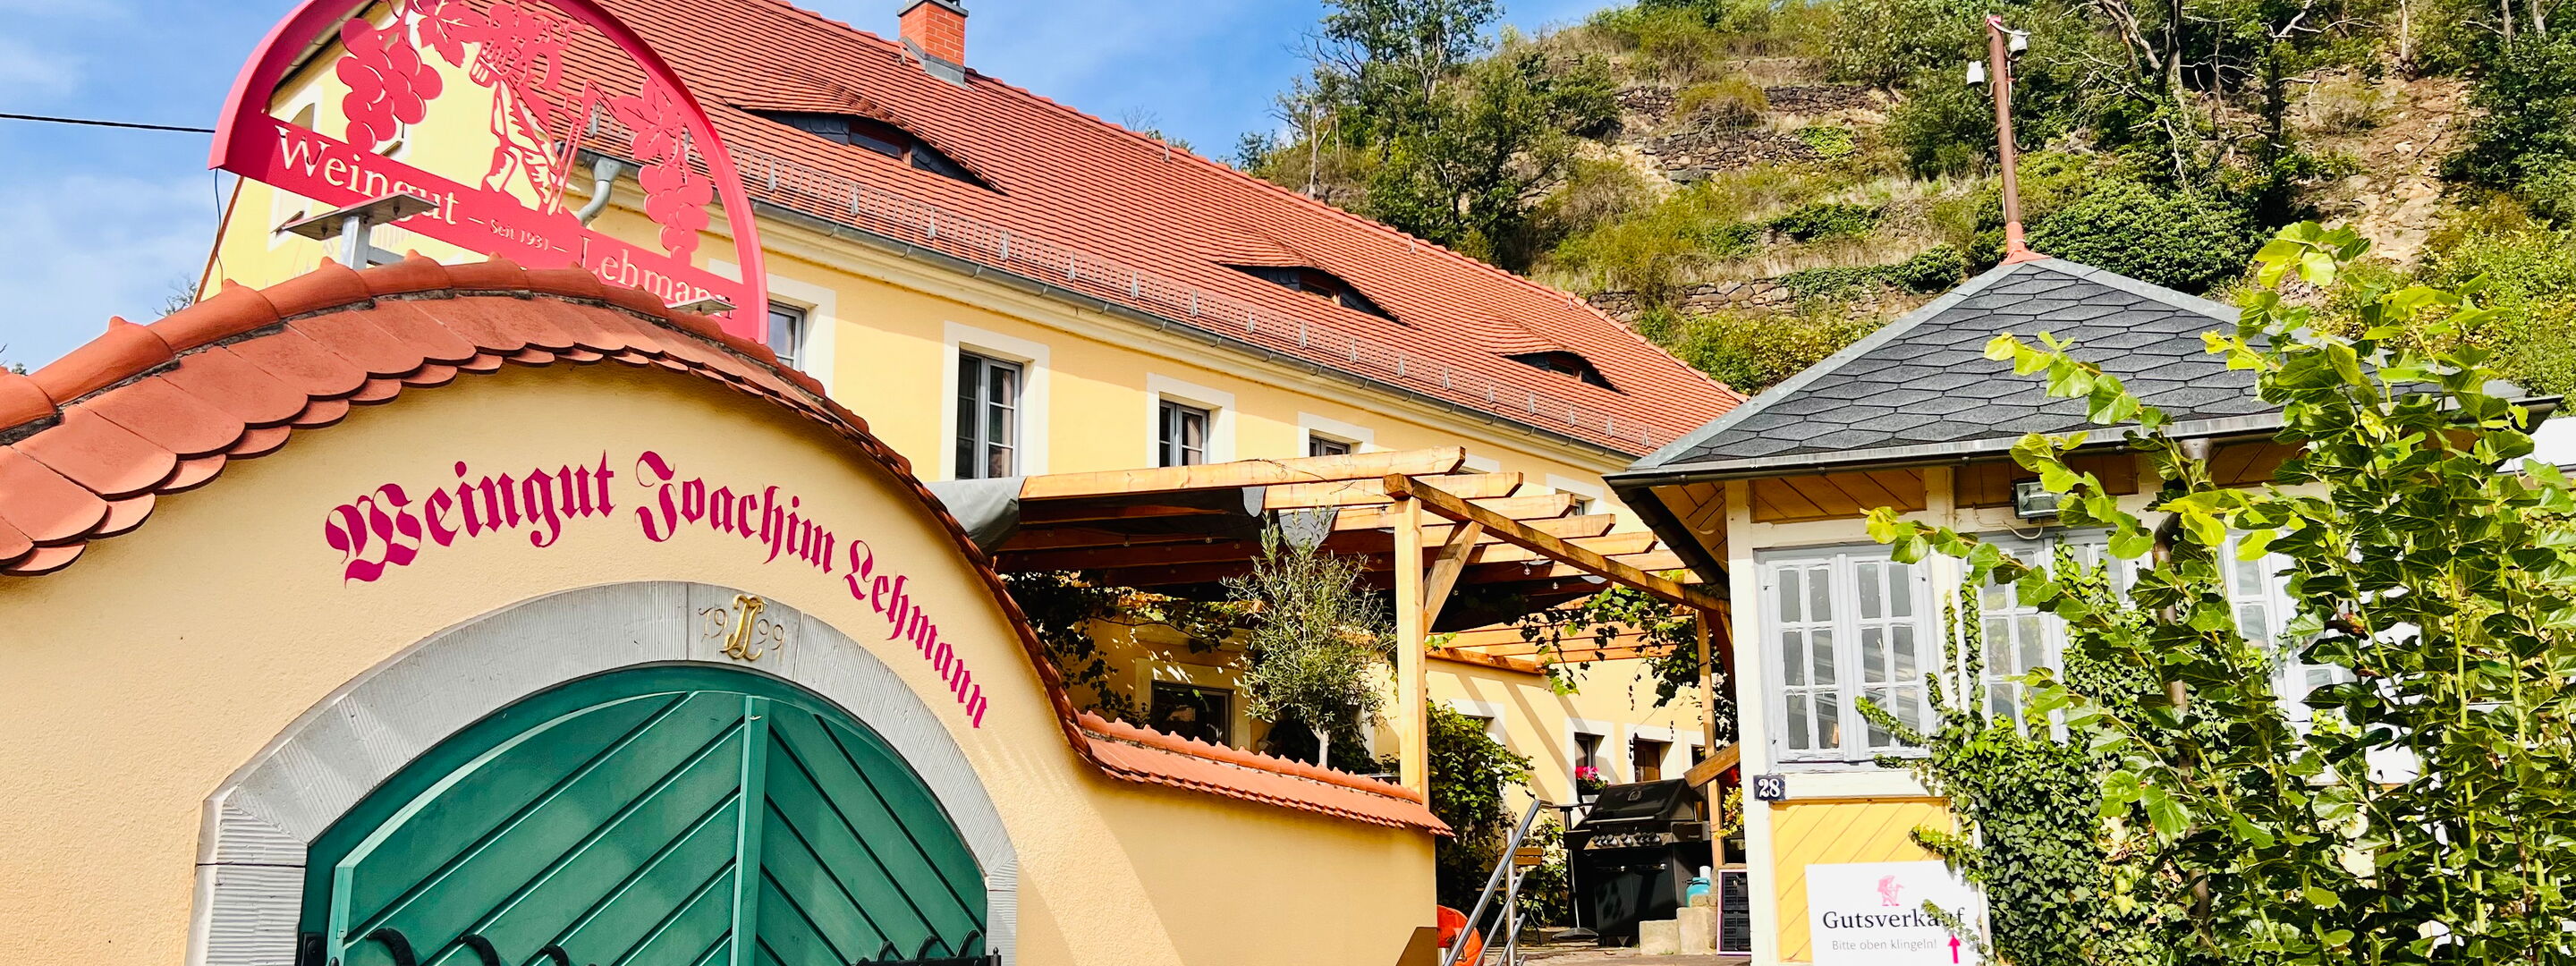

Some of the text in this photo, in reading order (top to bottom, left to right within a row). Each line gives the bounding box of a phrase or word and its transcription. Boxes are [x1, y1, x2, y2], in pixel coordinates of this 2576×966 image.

[490, 218, 515, 240] Seit
[325, 450, 987, 730] Weingut Joachim Lehmann
[1758, 778, 1781, 798] 28
[1832, 938, 1937, 952] Bitte oben klingeln!
